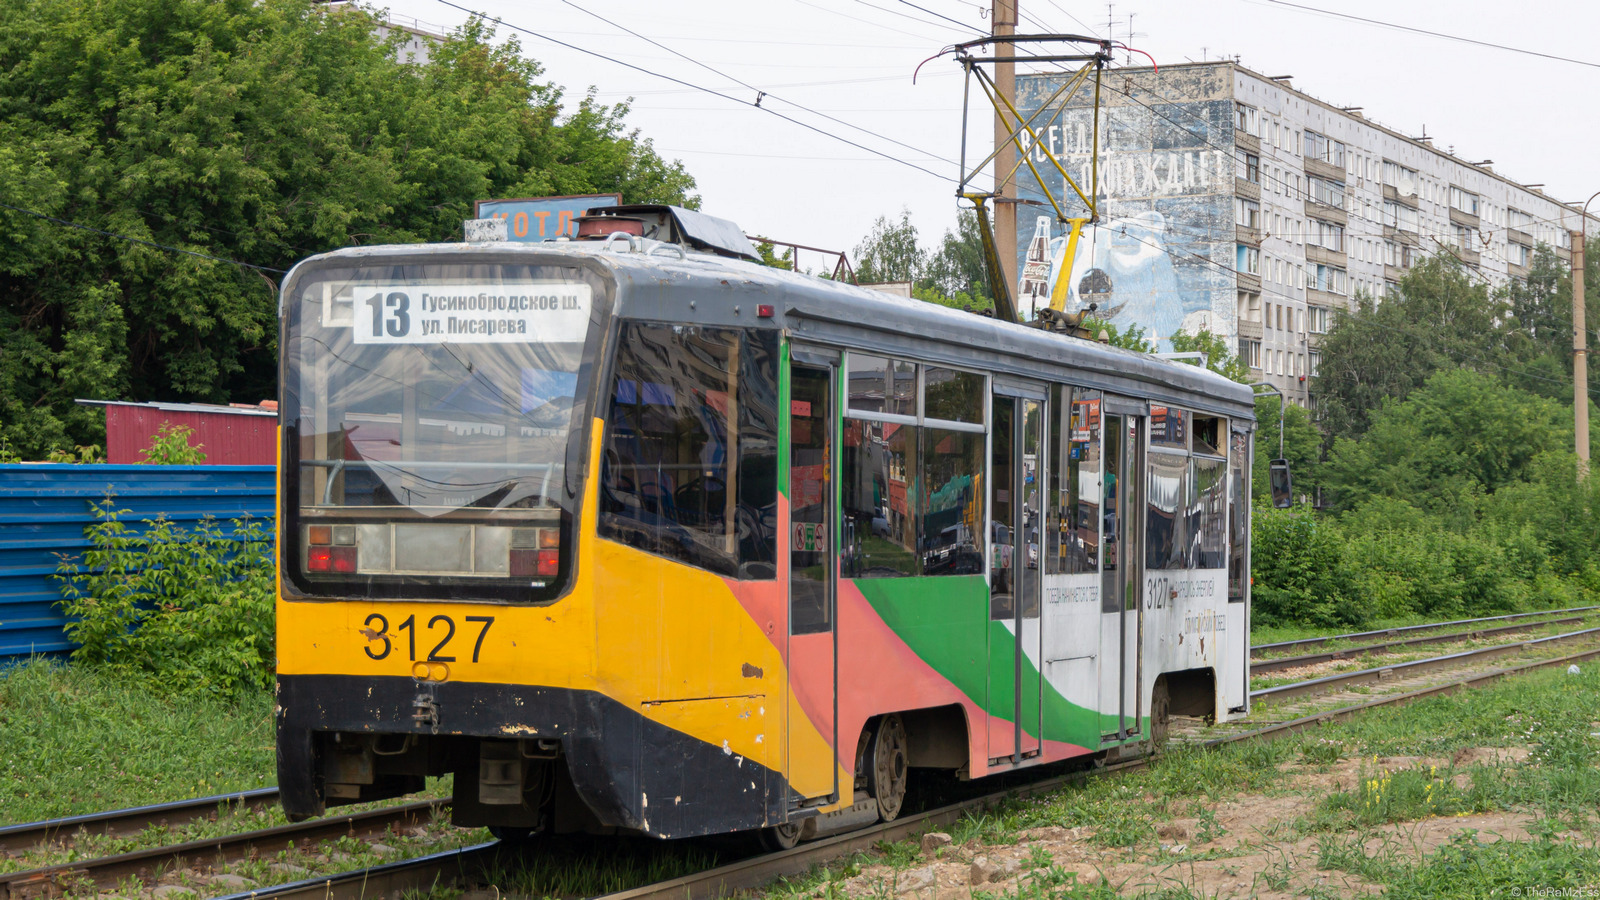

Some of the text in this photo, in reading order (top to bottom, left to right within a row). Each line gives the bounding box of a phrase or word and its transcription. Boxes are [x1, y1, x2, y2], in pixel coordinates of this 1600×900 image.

[1081, 149, 1226, 197] ОХЛАЖДАЕТ
[366, 292, 411, 338] 13
[422, 293, 581, 313] Гусинобродское ш.
[422, 316, 527, 335] ул. Писарева
[1147, 577, 1168, 609] 3127
[363, 613, 495, 663] 3127
